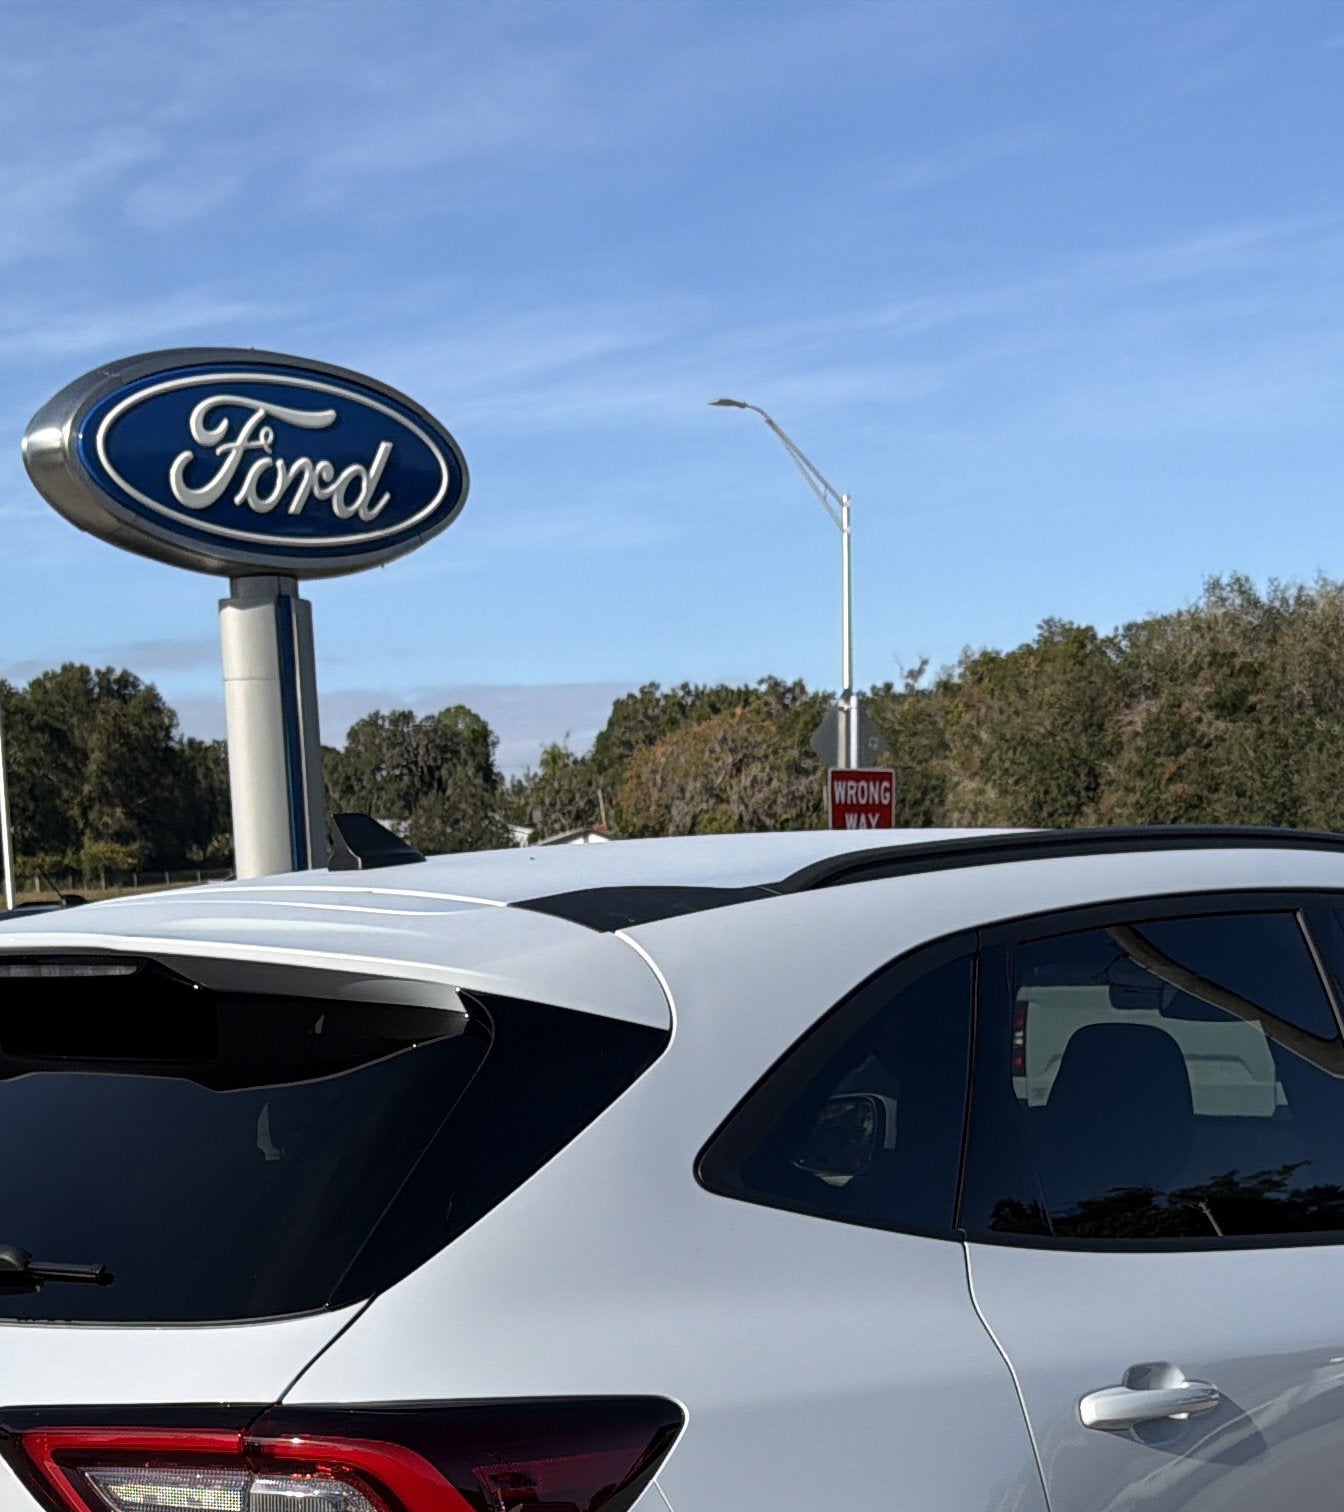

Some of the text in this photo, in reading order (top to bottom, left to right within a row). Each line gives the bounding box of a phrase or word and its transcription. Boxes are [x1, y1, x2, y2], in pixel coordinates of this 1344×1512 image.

[169, 394, 392, 522] Ford
[833, 779, 891, 805] WRONG
[845, 813, 881, 830] WAY
